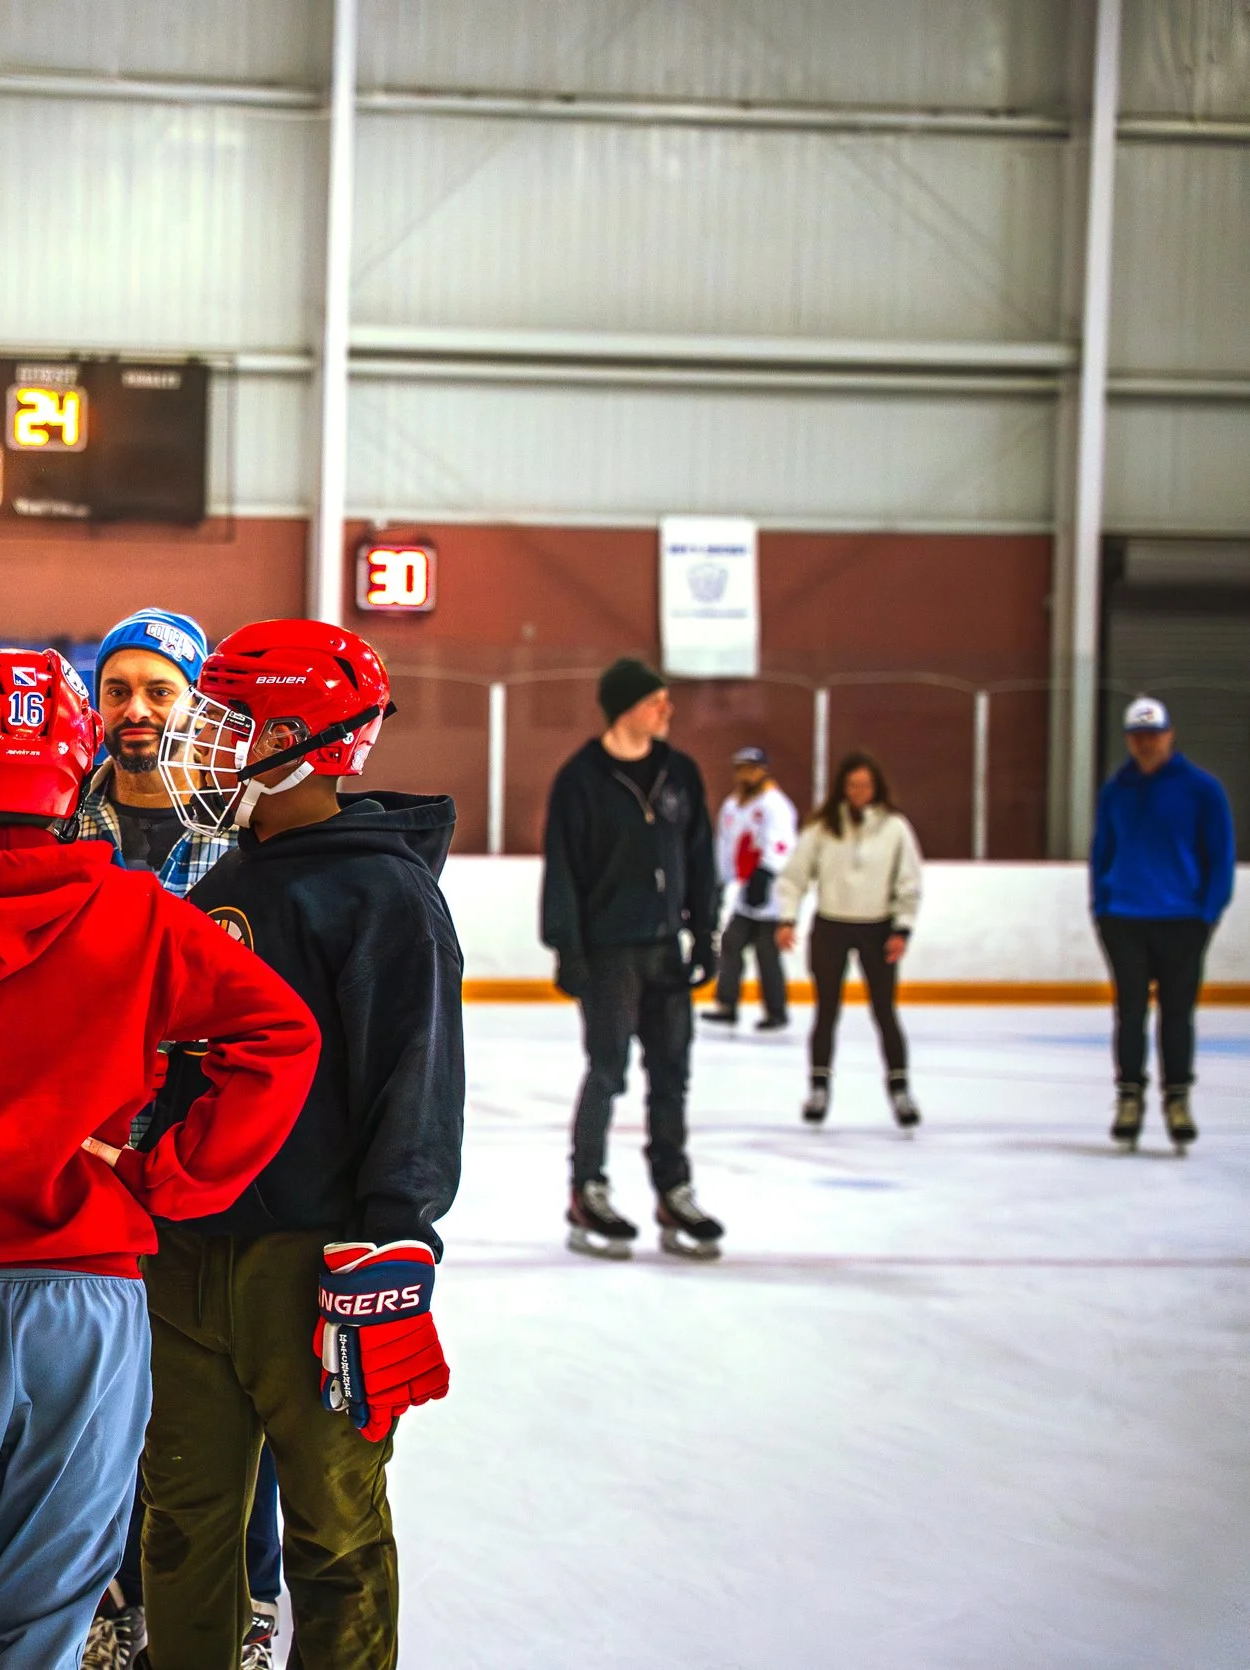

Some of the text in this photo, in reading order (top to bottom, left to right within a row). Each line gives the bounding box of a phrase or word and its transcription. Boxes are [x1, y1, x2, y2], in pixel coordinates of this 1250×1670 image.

[14, 387, 80, 447] 24
[367, 549, 429, 606] 30
[8, 691, 45, 727] 16
[319, 1284, 422, 1316] NGERS
[339, 1333, 352, 1398] KITCHENER
